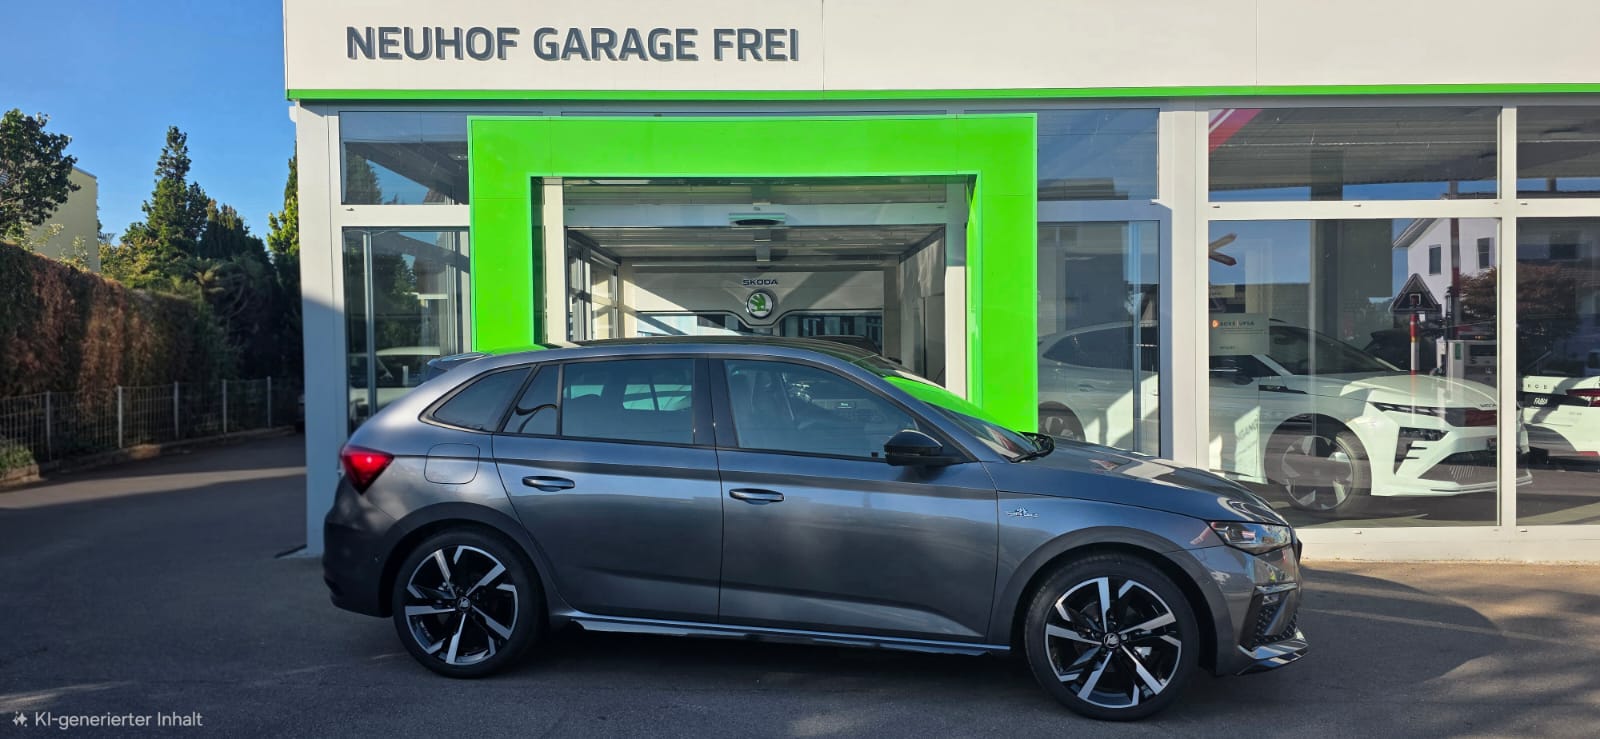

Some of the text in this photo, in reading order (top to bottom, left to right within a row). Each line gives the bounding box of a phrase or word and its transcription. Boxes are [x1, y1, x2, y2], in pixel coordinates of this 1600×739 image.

[346, 26, 799, 62] NEUHOF GARAGE FREI
